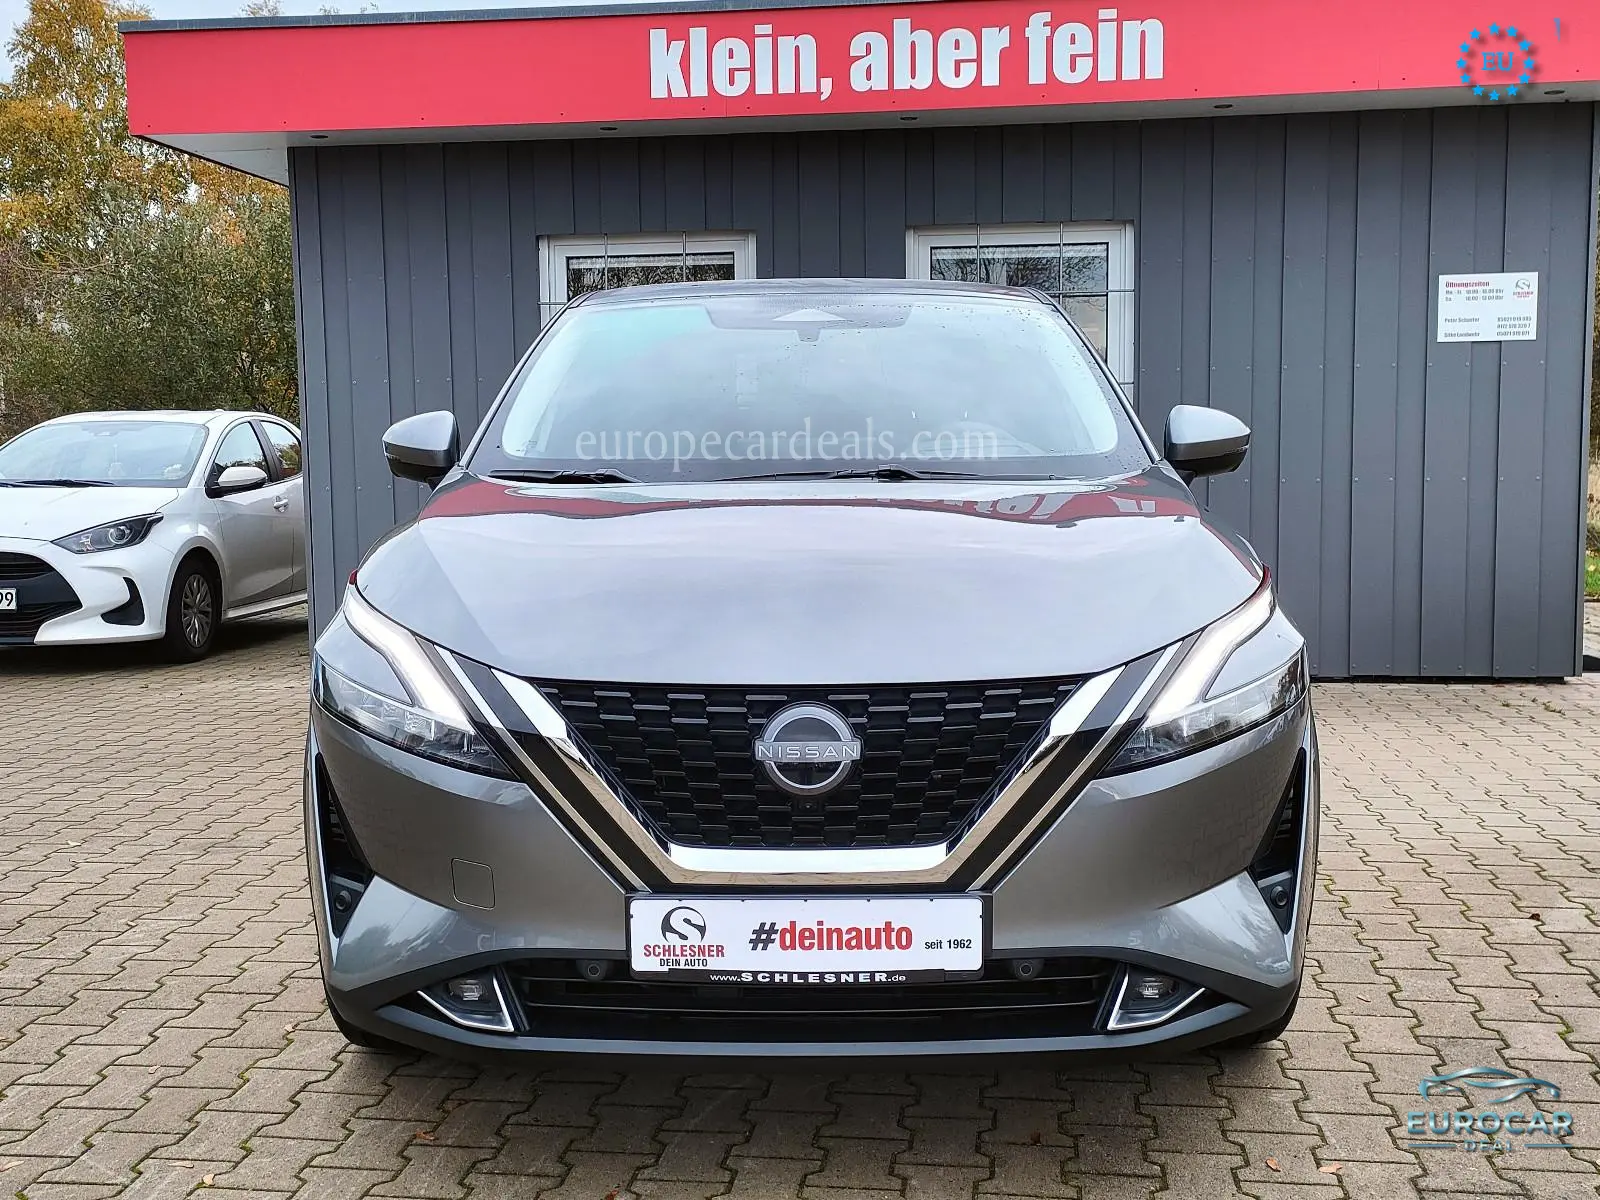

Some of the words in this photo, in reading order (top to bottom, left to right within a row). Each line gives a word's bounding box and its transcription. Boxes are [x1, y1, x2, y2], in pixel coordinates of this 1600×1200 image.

[649, 24, 832, 101] klein,
[849, 18, 1011, 92] aber
[1025, 8, 1165, 85] fein
[758, 745, 857, 758] NISSAN
[748, 921, 913, 951] #deinauto
[924, 939, 943, 950] seit
[946, 938, 972, 949] 1962
[643, 944, 725, 958] SCHLESNER
[659, 958, 681, 967] DEIN
[684, 958, 708, 967] AUTO
[709, 972, 906, 983] www.SCHLESNER.de
